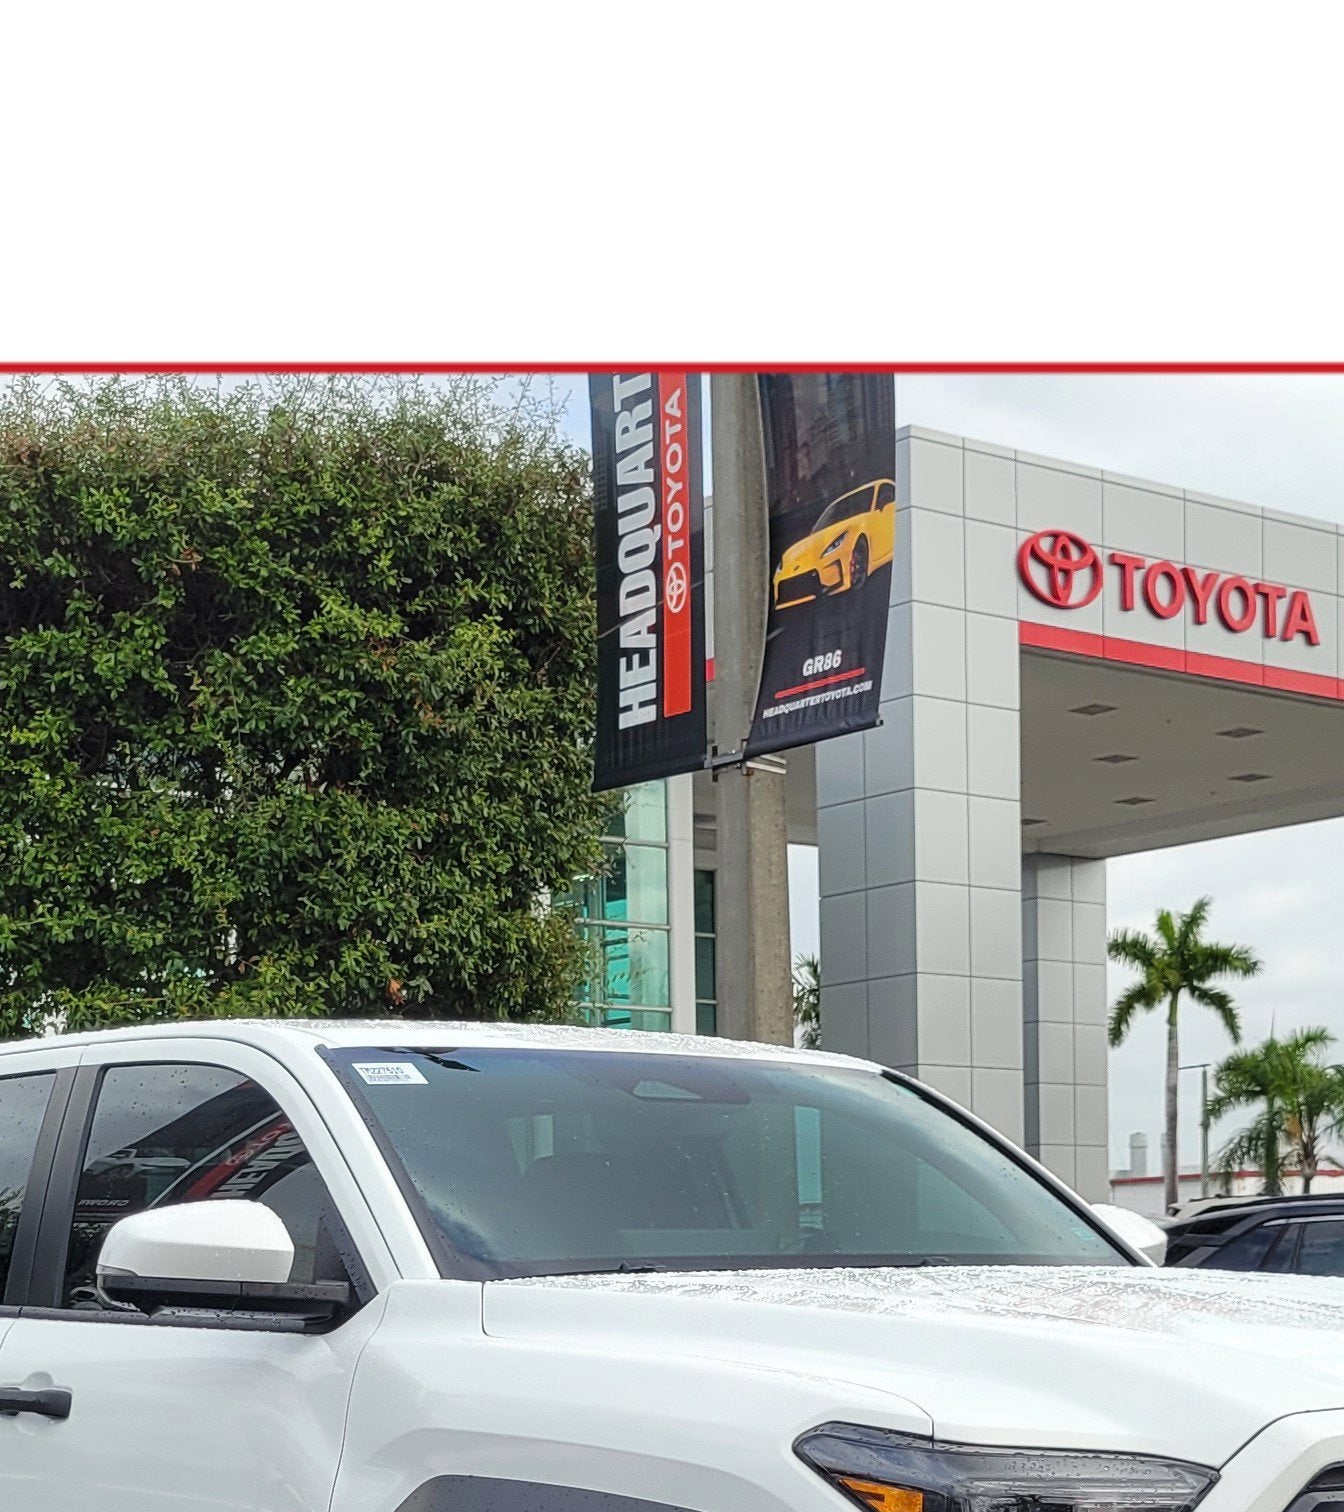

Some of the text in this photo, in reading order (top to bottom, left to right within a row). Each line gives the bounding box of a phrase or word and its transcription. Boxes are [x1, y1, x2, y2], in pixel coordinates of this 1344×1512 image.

[664, 387, 684, 555] TOYOTA
[1110, 552, 1320, 645] TOYOTA
[802, 649, 843, 677] GR86
[762, 680, 873, 719] HEADQUARTERTOYOTA.COM
